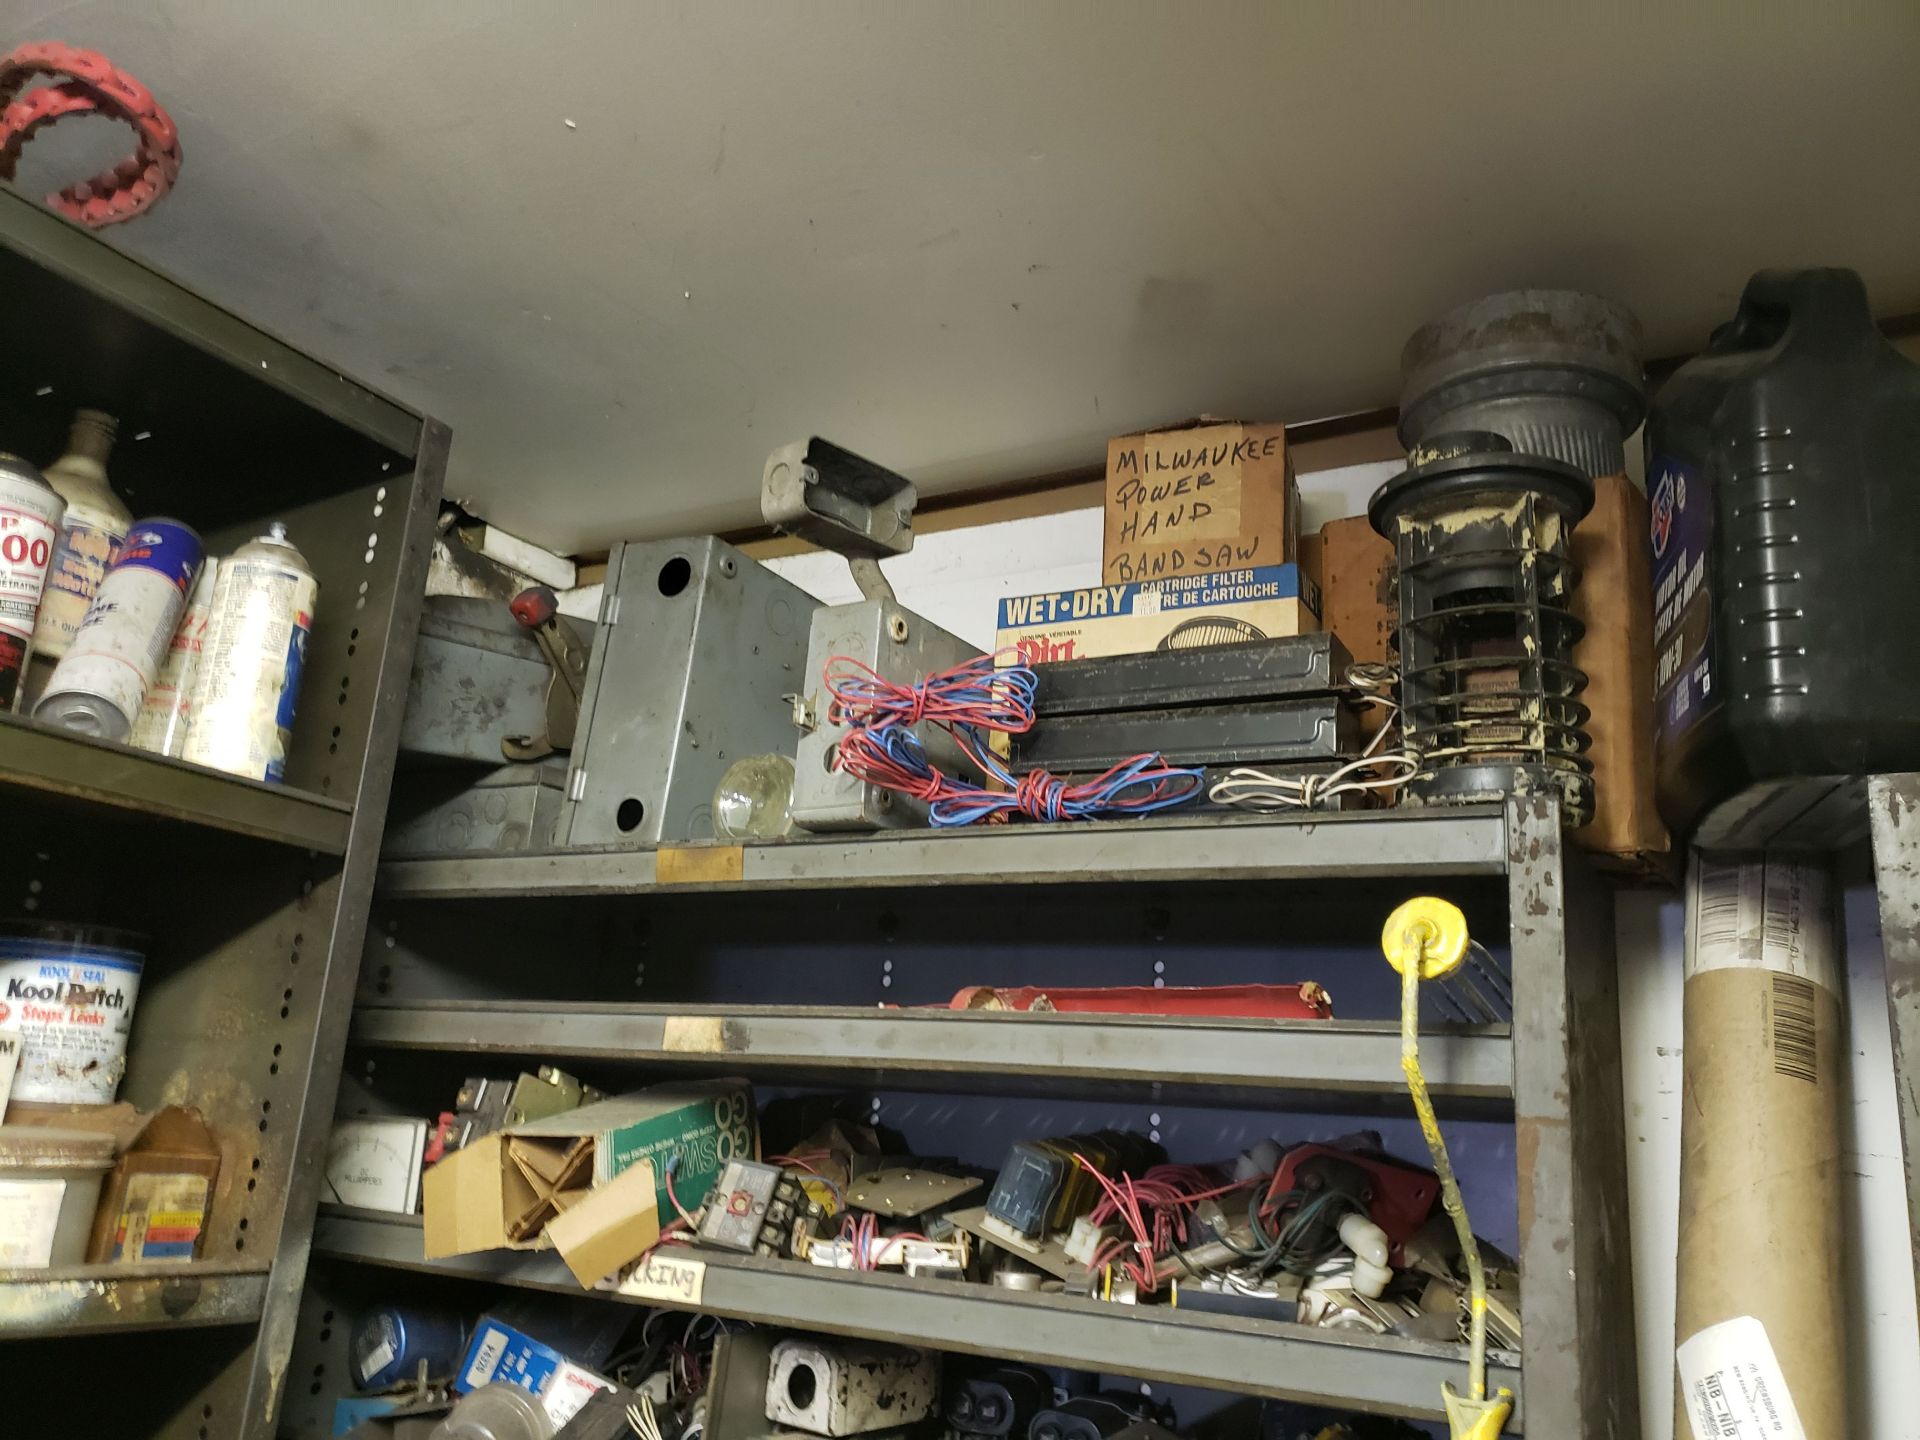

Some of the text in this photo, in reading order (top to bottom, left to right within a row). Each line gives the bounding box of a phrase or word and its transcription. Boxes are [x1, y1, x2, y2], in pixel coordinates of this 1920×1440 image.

[1116, 436, 1279, 474] MILWAUKEE
[1116, 471, 1215, 511] POWER
[1120, 502, 1212, 544] HAND
[1140, 569, 1254, 595] CARTRIDGE FILTER
[1182, 590, 1199, 605] DE
[1202, 581, 1279, 603] CARTOUCHE
[1016, 637, 1077, 665] Dirt
[6, 978, 64, 1002] Kool
[21, 1003, 65, 1025] Stops
[68, 1008, 106, 1026] Leaks
